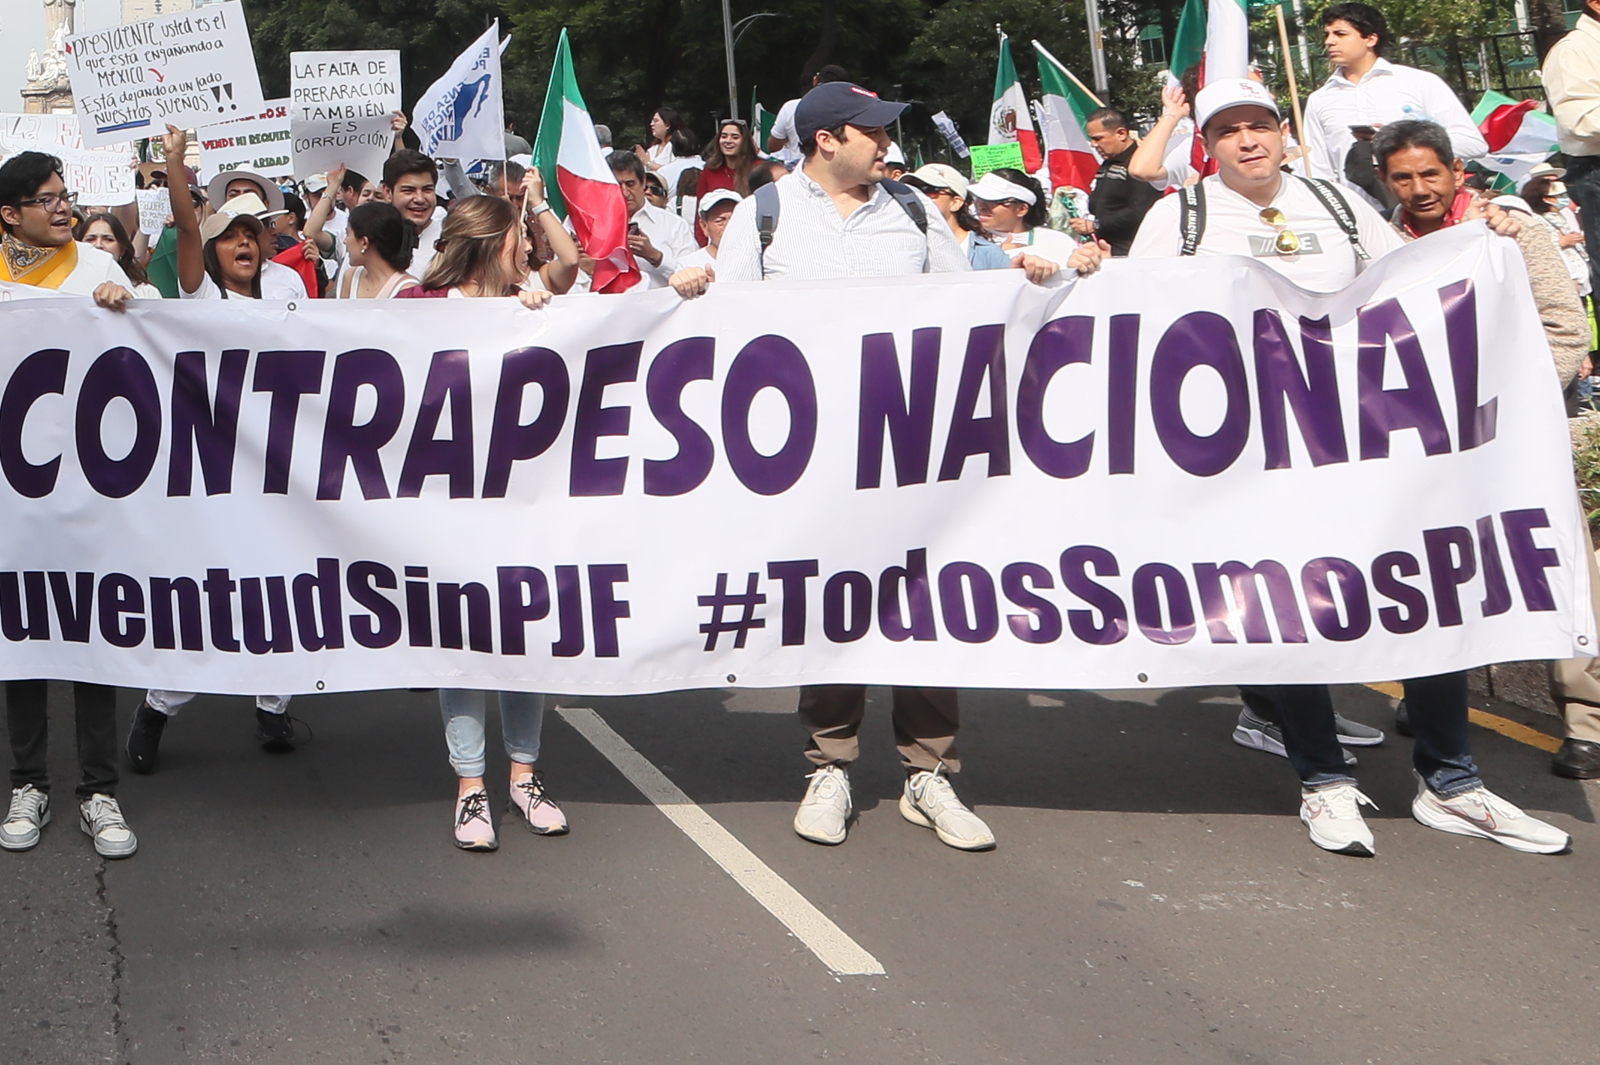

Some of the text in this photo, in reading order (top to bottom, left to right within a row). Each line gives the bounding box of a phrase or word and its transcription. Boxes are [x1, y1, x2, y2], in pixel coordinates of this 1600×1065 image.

[195, 16, 211, 32] es
[212, 10, 228, 31] el
[85, 55, 107, 74] que
[214, 39, 225, 50] a
[295, 60, 387, 79] LA FALTA DE
[302, 99, 385, 121] TAMBIÉN
[331, 120, 358, 134] ES
[201, 137, 234, 150] VENDE
[248, 129, 292, 145] REQUIER
[294, 129, 389, 154] CORRUPCIÓN
[855, 278, 1499, 490] NACIONAL
[697, 507, 1561, 652] #TodosSomosPJF
